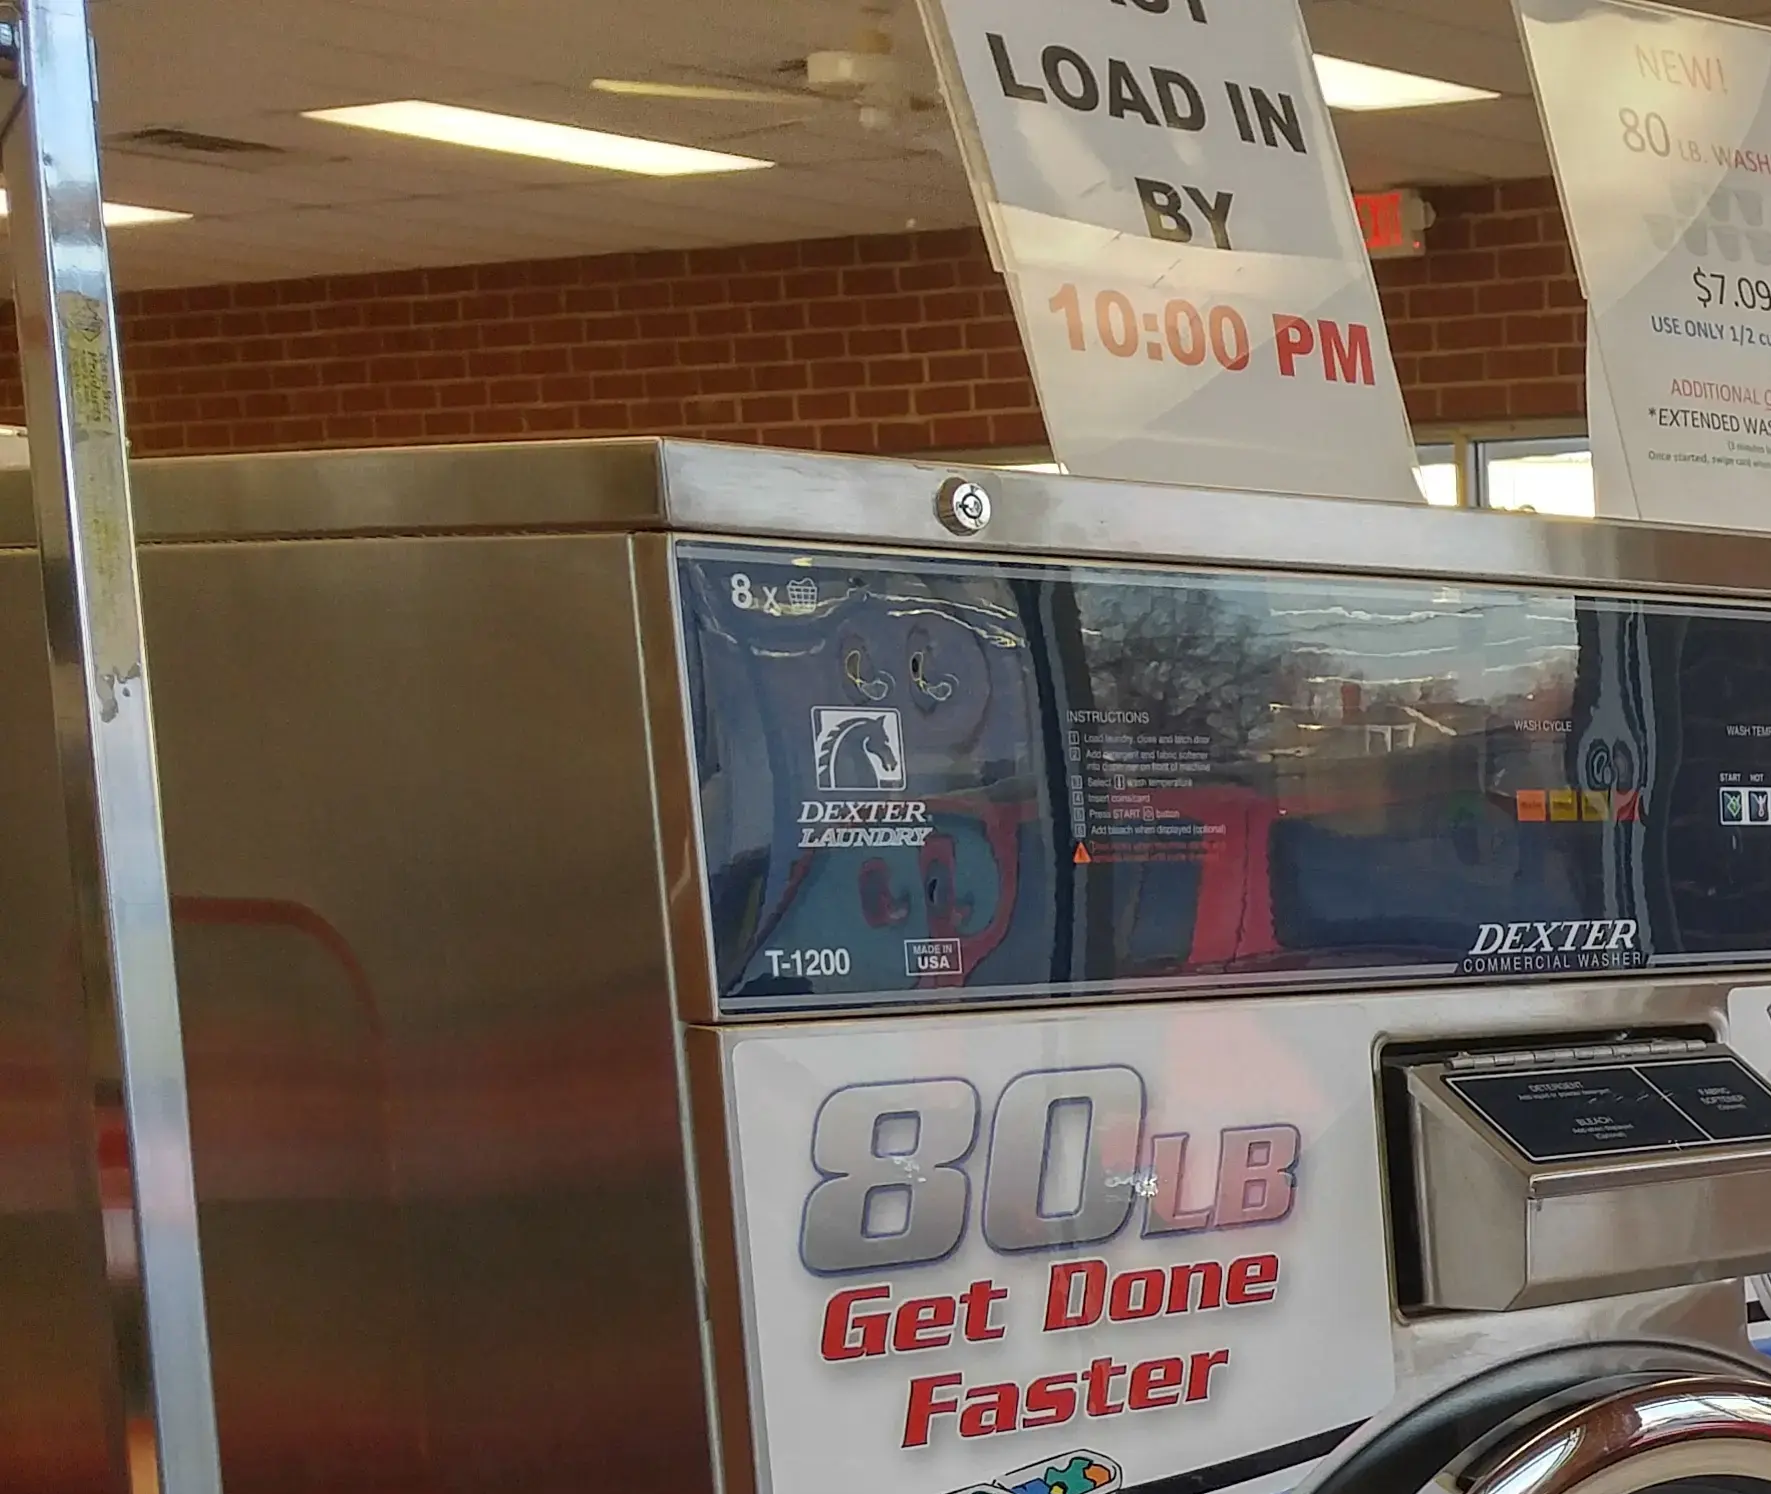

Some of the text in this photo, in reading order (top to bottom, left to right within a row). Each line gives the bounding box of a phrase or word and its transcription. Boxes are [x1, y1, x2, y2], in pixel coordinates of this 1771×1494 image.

[1635, 44, 1728, 95] NEW!
[985, 32, 1307, 154] LOAD IN
[1618, 107, 1671, 157] 80
[1677, 138, 1708, 164] LB.
[1134, 176, 1234, 250] BY
[1048, 282, 1376, 386] 10:00 PM
[1651, 315, 1681, 335] USE
[1685, 320, 1724, 341] ONLY
[1730, 325, 1755, 346] 1/2
[1671, 379, 1761, 406] ADDITIONAL
[1648, 450, 1709, 464] Once started,
[730, 574, 753, 609] 8
[1066, 711, 1150, 724] INSTRUCTIONS
[1514, 720, 1572, 732] WASH CYCLE
[1727, 726, 1750, 736] WASH
[1720, 773, 1741, 782] START
[798, 800, 927, 824] DEXTER
[1113, 809, 1140, 818] START
[799, 827, 932, 847] LAUNDRY
[913, 943, 937, 955] MADE
[1469, 919, 1639, 955] DEXTER
[765, 948, 850, 977] T-1200
[918, 955, 950, 969] USA
[1463, 950, 1643, 974] COMMERCIAL WASHER
[819, 1254, 1280, 1363] Get Done
[902, 1348, 1230, 1450] Faster
